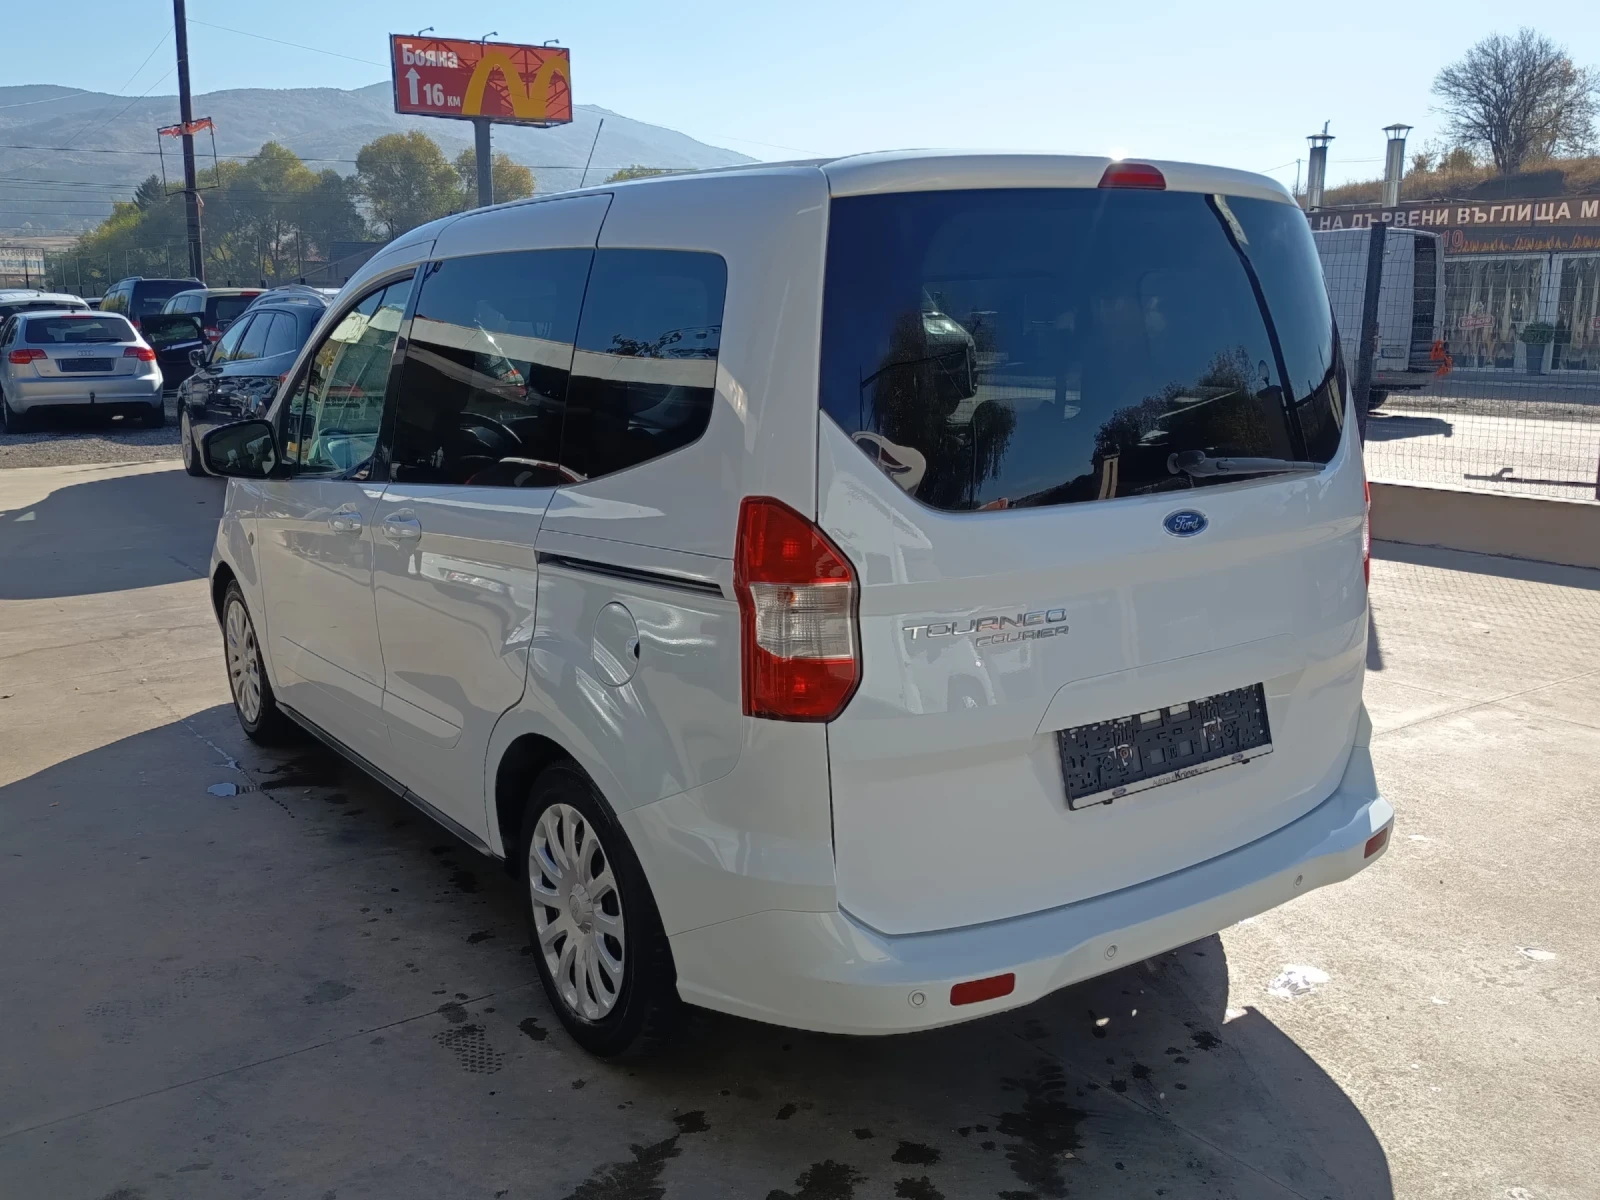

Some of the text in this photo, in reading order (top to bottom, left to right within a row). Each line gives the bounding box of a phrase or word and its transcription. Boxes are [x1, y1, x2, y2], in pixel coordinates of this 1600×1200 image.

[402, 43, 458, 69] Бояна
[423, 83, 445, 107] 16
[1320, 215, 1344, 231] НА
[1456, 201, 1571, 225] ВЪГЛИЩА
[1174, 514, 1199, 531] Ford
[902, 608, 1067, 640] TOURNEO
[976, 625, 1069, 648] COURIER
